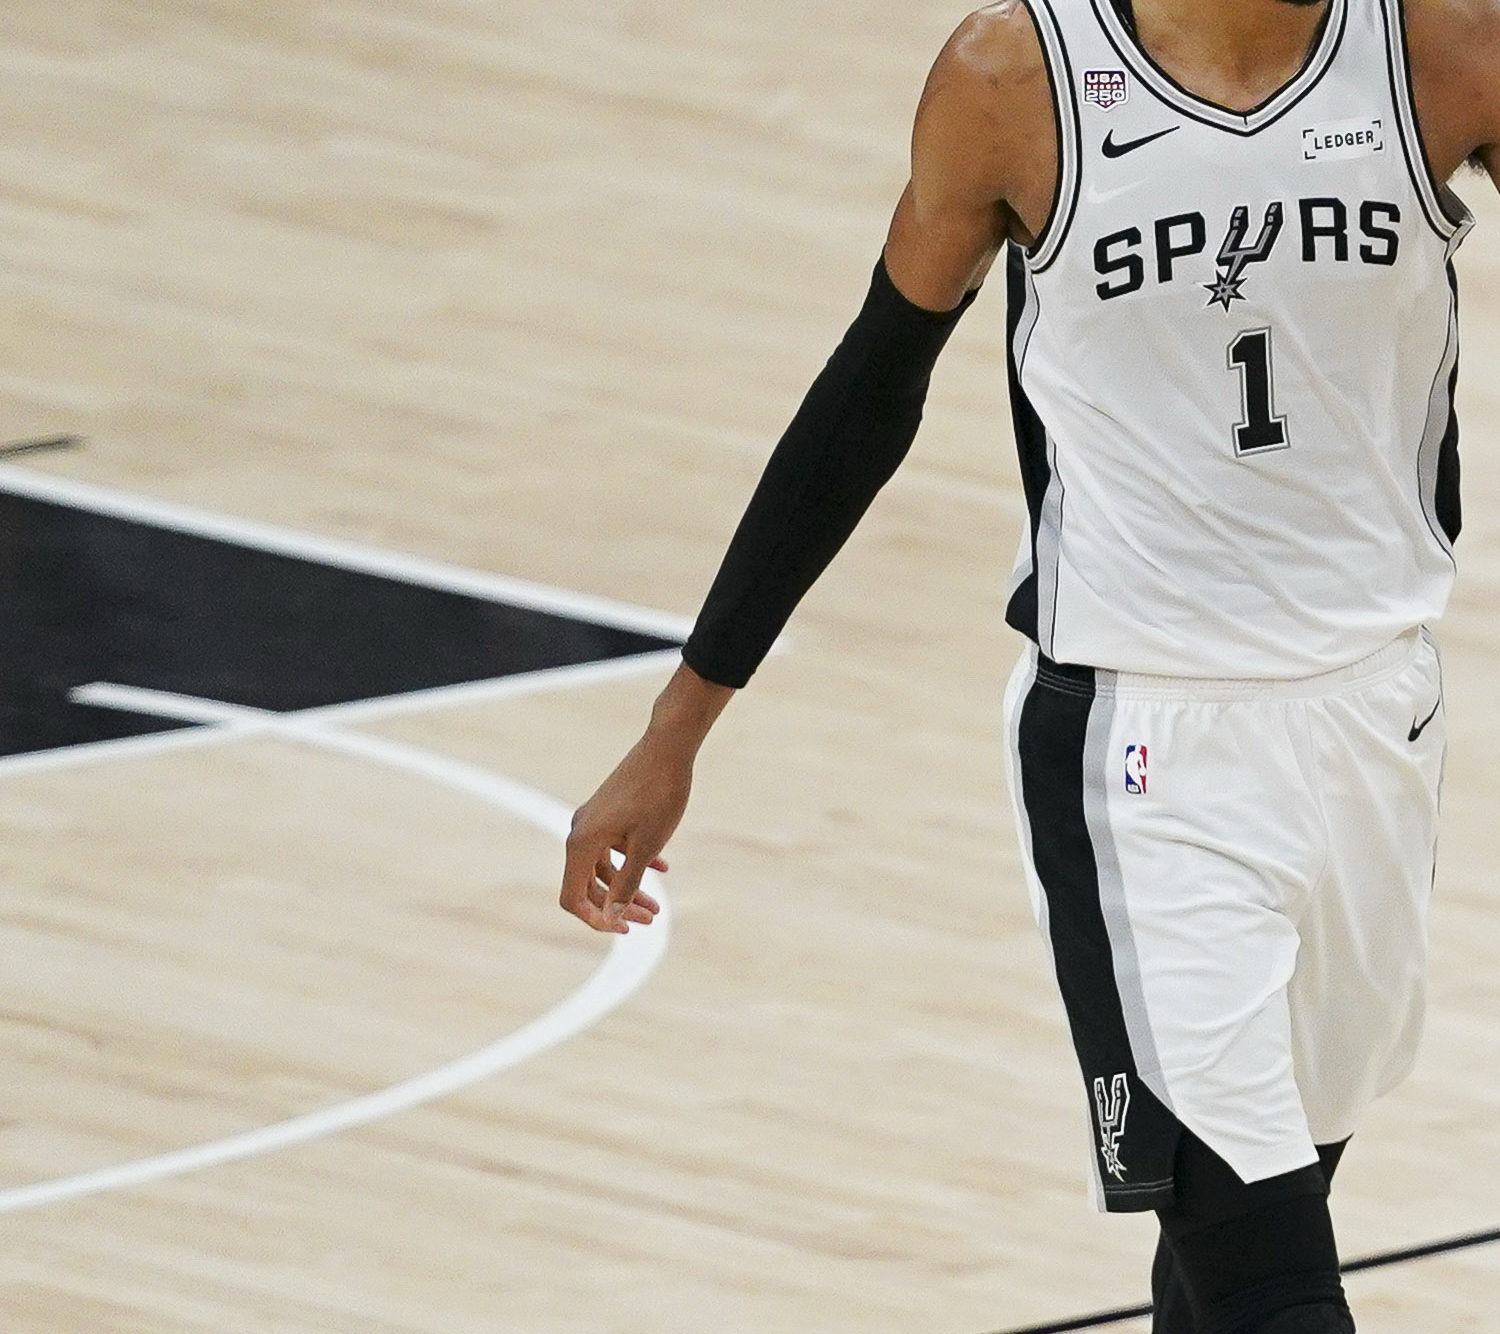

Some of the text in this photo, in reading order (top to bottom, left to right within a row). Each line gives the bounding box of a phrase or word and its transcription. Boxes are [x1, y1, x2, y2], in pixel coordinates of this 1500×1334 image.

[1086, 73, 1123, 84] USA
[1085, 89, 1126, 102] 250
[1314, 130, 1374, 150] LEDGER
[1093, 197, 1401, 313] SPURS
[1226, 325, 1291, 458] 1
